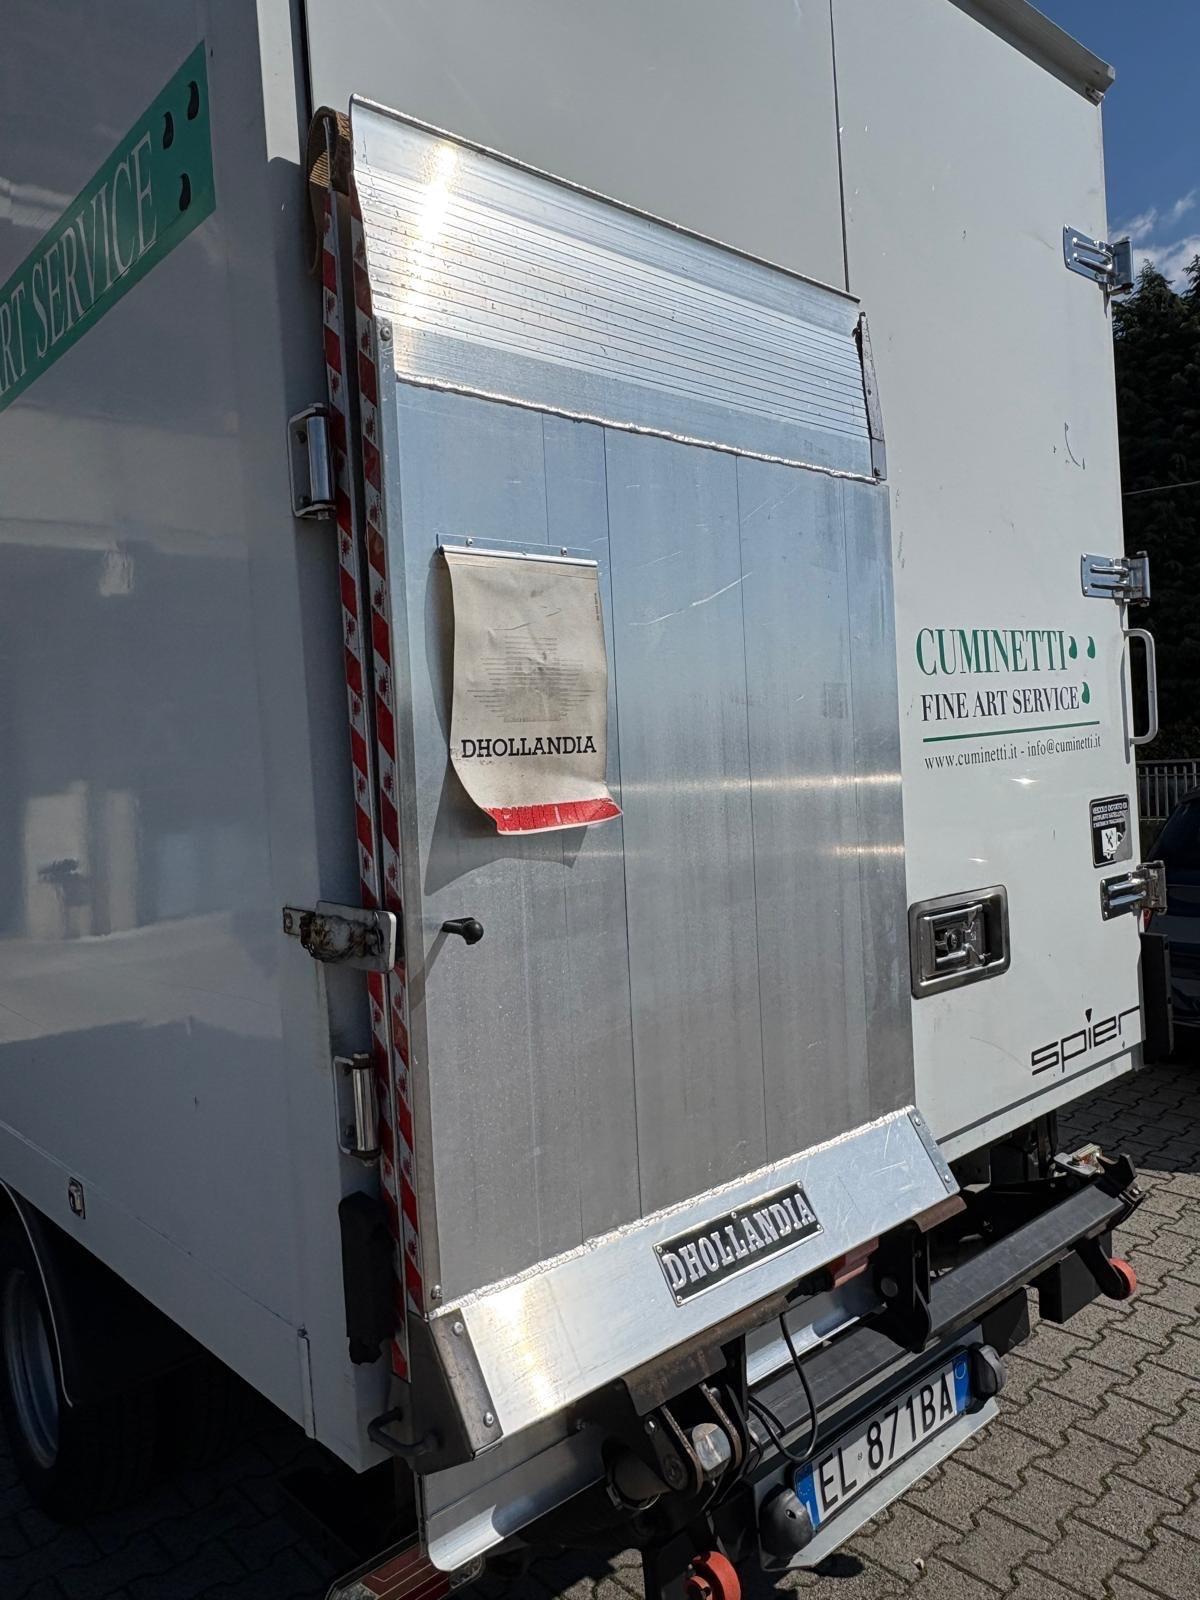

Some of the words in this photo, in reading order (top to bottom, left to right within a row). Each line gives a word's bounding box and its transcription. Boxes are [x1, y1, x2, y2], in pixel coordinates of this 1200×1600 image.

[0, 281, 26, 394] RT
[32, 131, 157, 358] SERVICE
[916, 628, 1067, 675] CUMINETTI
[920, 692, 969, 721] FINE
[973, 690, 1008, 717] ART
[1012, 686, 1080, 714] SERVICE
[461, 736, 597, 758] DHOLLANDIA
[925, 743, 1017, 770] www.cuminetti.it
[1027, 733, 1101, 757] info@cuminetti.it
[1031, 1005, 1140, 1076] spier
[661, 1193, 817, 1291] DHOLLANDIA
[818, 1446, 857, 1512] EL
[866, 1373, 953, 1470] 871BA
